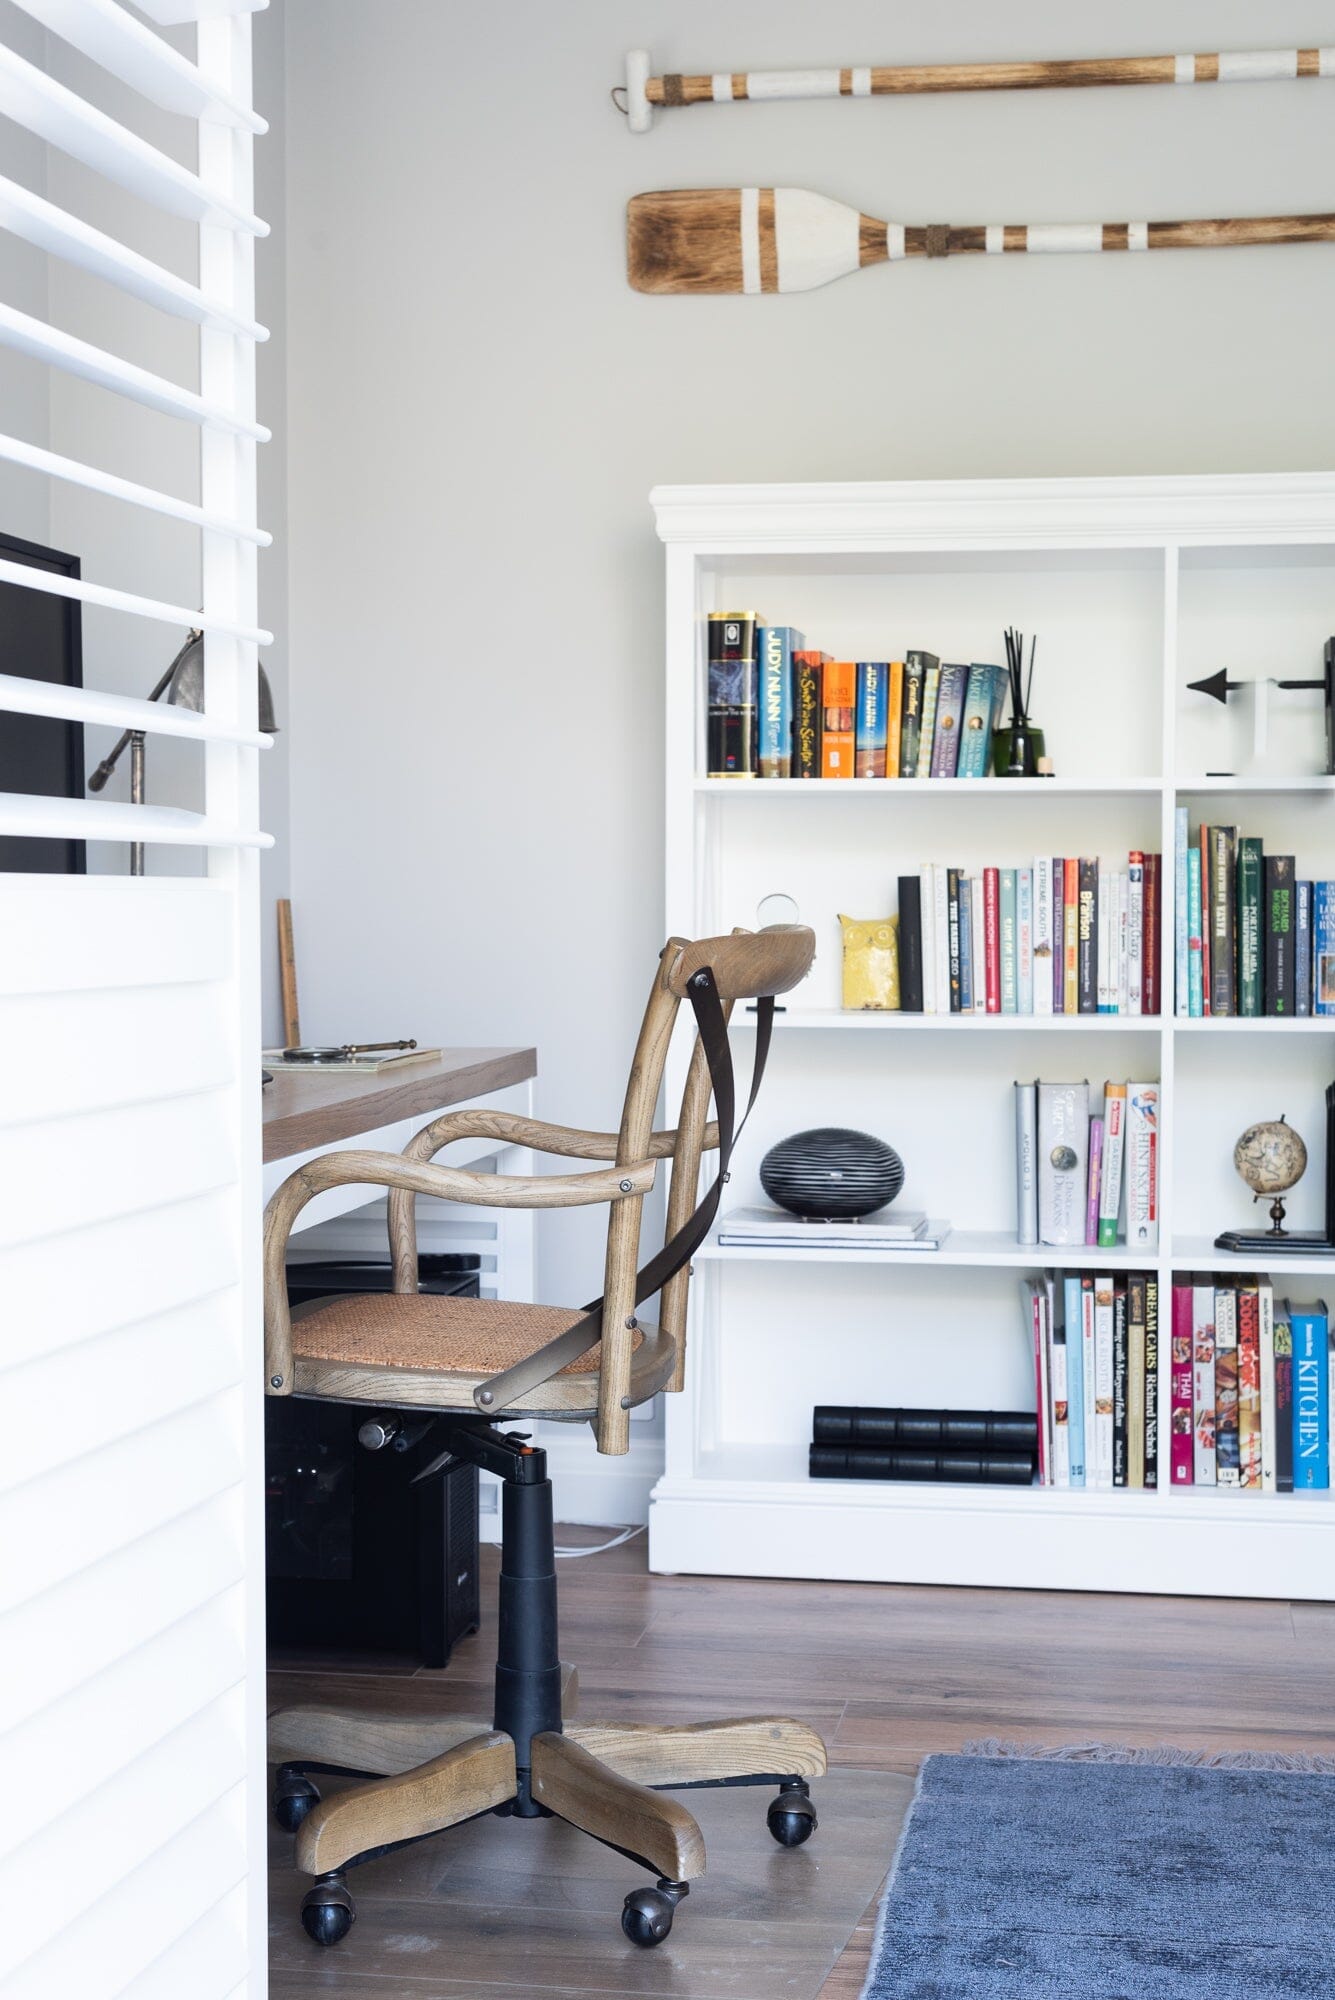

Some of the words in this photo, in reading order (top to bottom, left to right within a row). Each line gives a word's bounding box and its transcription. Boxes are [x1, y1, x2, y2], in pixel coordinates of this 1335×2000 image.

[767, 631, 781, 674] JUDY
[801, 678, 816, 709] Sword
[866, 666, 877, 694] JUDY
[767, 676, 781, 722] NUNN
[866, 695, 876, 728] NUNN
[1039, 861, 1047, 903] EXTREME
[1299, 887, 1307, 908] GREG
[950, 901, 958, 921] THE
[1039, 906, 1047, 937] SOUTH
[1080, 891, 1093, 940] Branson
[1129, 893, 1142, 927] Leading
[1216, 905, 1227, 937] MALTA
[1272, 889, 1281, 932] MORGAN
[1280, 889, 1289, 932] RICHARD
[1299, 908, 1307, 929] BEAR
[950, 922, 959, 957] NAKED
[1249, 905, 1257, 952] PORTABLE
[951, 958, 959, 975] CEO
[1249, 954, 1258, 974] MBA
[1023, 1133, 1031, 1174] APOLLO
[1110, 1139, 1121, 1181] GARDEN
[1108, 1183, 1118, 1215] GUIDE
[1146, 1282, 1157, 1330] DREAM
[1218, 1299, 1226, 1308] IN
[1218, 1311, 1226, 1345] COLOUR
[1146, 1333, 1157, 1368] CARS
[1099, 1347, 1109, 1393] RISOTTO
[1181, 1372, 1192, 1399] THAI
[1146, 1373, 1157, 1417] Richard
[1277, 1391, 1286, 1409] Table
[1298, 1360, 1319, 1458] KITCHEN
[1146, 1419, 1157, 1458] Nichols
